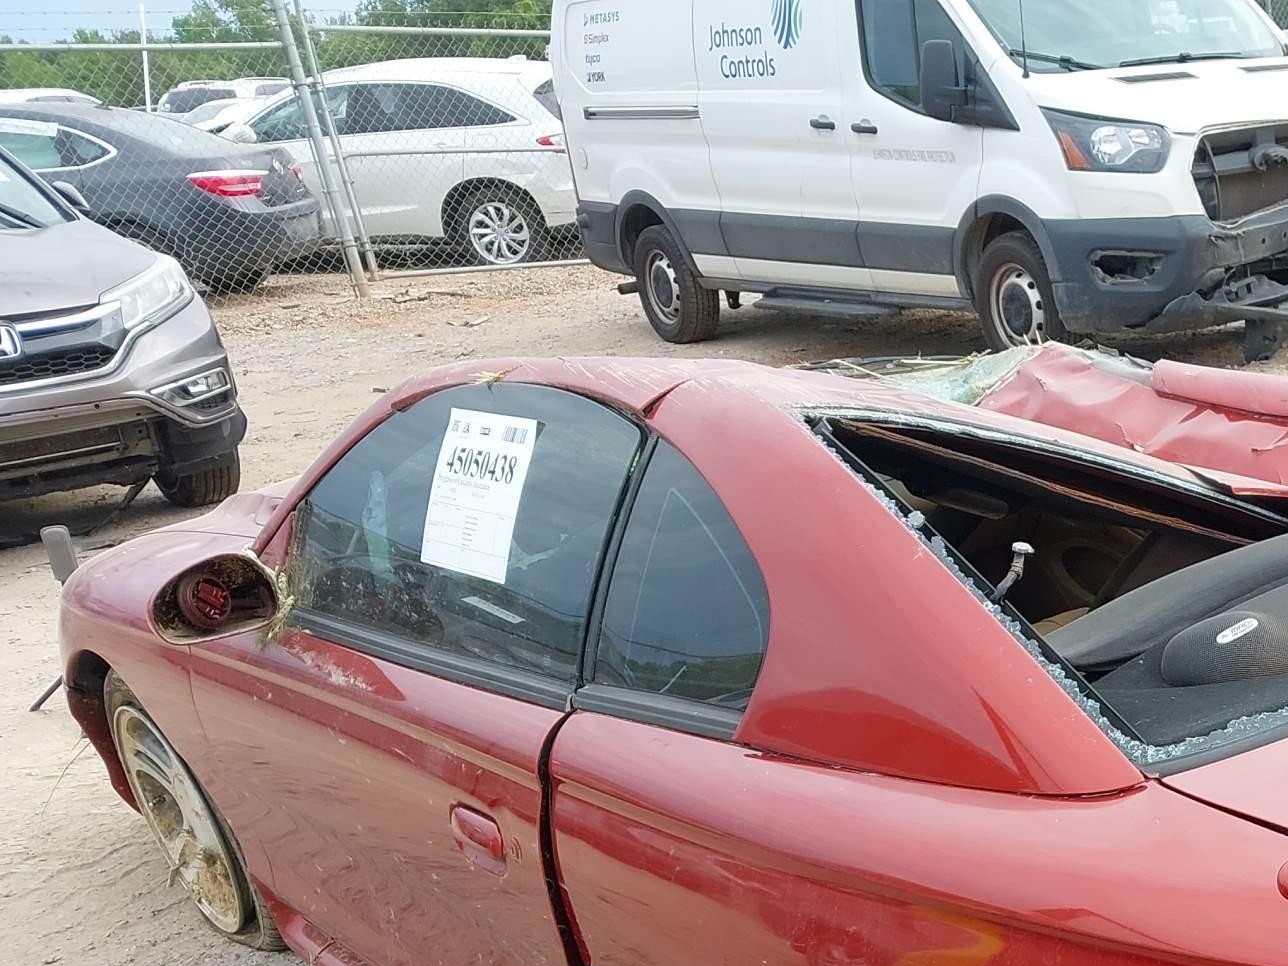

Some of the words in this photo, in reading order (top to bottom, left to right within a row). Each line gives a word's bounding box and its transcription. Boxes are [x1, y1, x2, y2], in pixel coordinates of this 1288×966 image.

[589, 12, 620, 25] METASYS
[709, 22, 762, 51] Johnson
[585, 53, 601, 66] tyco
[720, 49, 776, 78] Controls
[591, 72, 606, 83] YORK
[446, 446, 518, 484] 45050438
